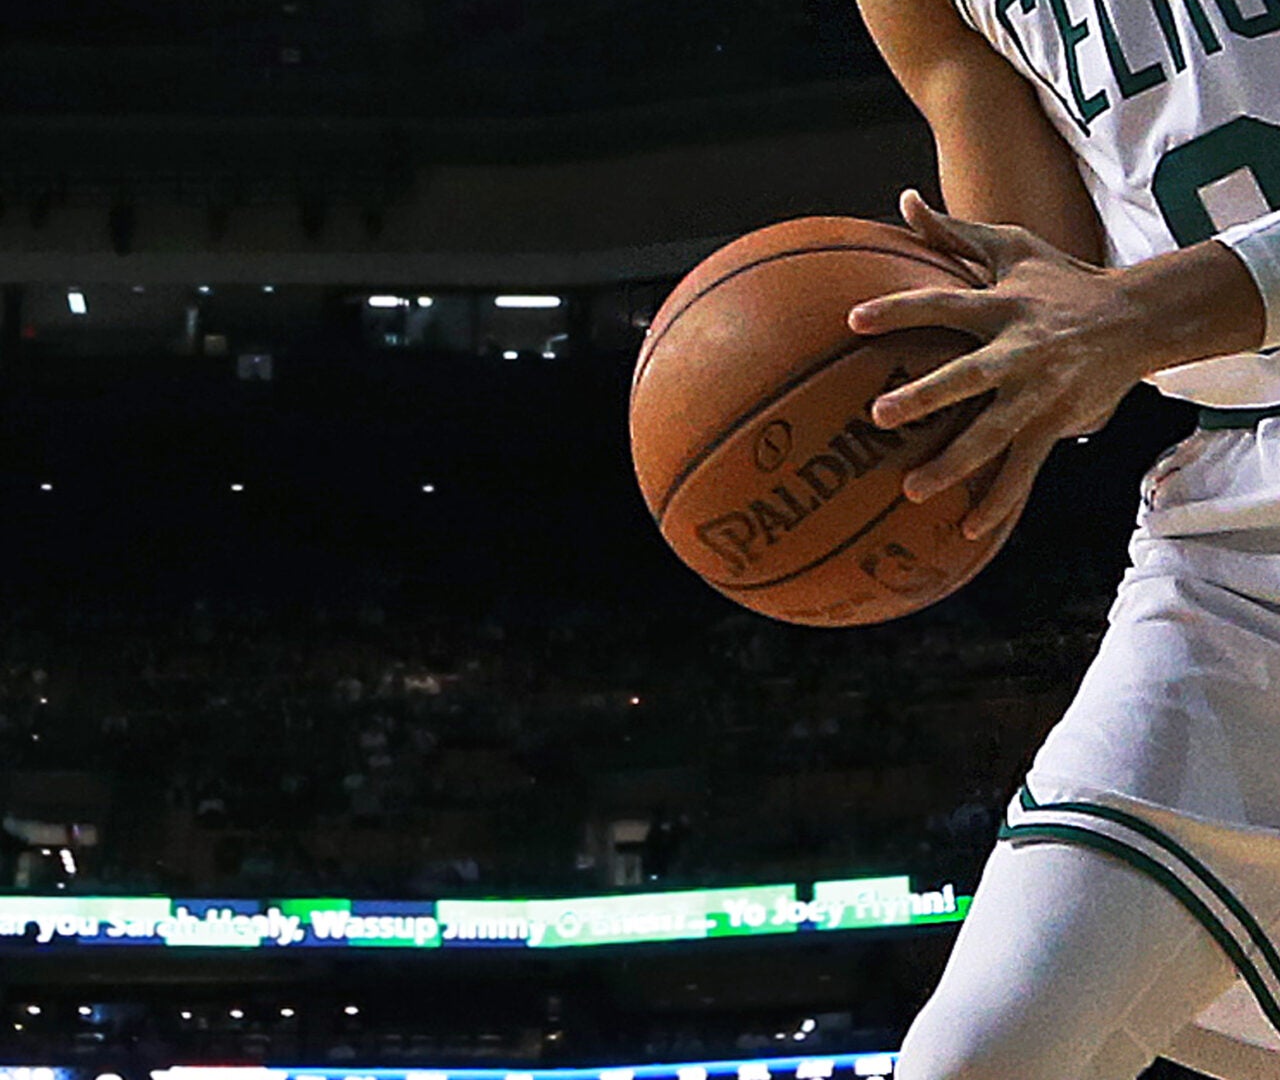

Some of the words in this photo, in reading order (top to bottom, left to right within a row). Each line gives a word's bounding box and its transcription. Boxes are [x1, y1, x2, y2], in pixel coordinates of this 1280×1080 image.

[696, 390, 912, 577] SPALDIN
[37, 915, 99, 943] you
[310, 909, 439, 945] Wassup
[723, 899, 767, 928] Yo
